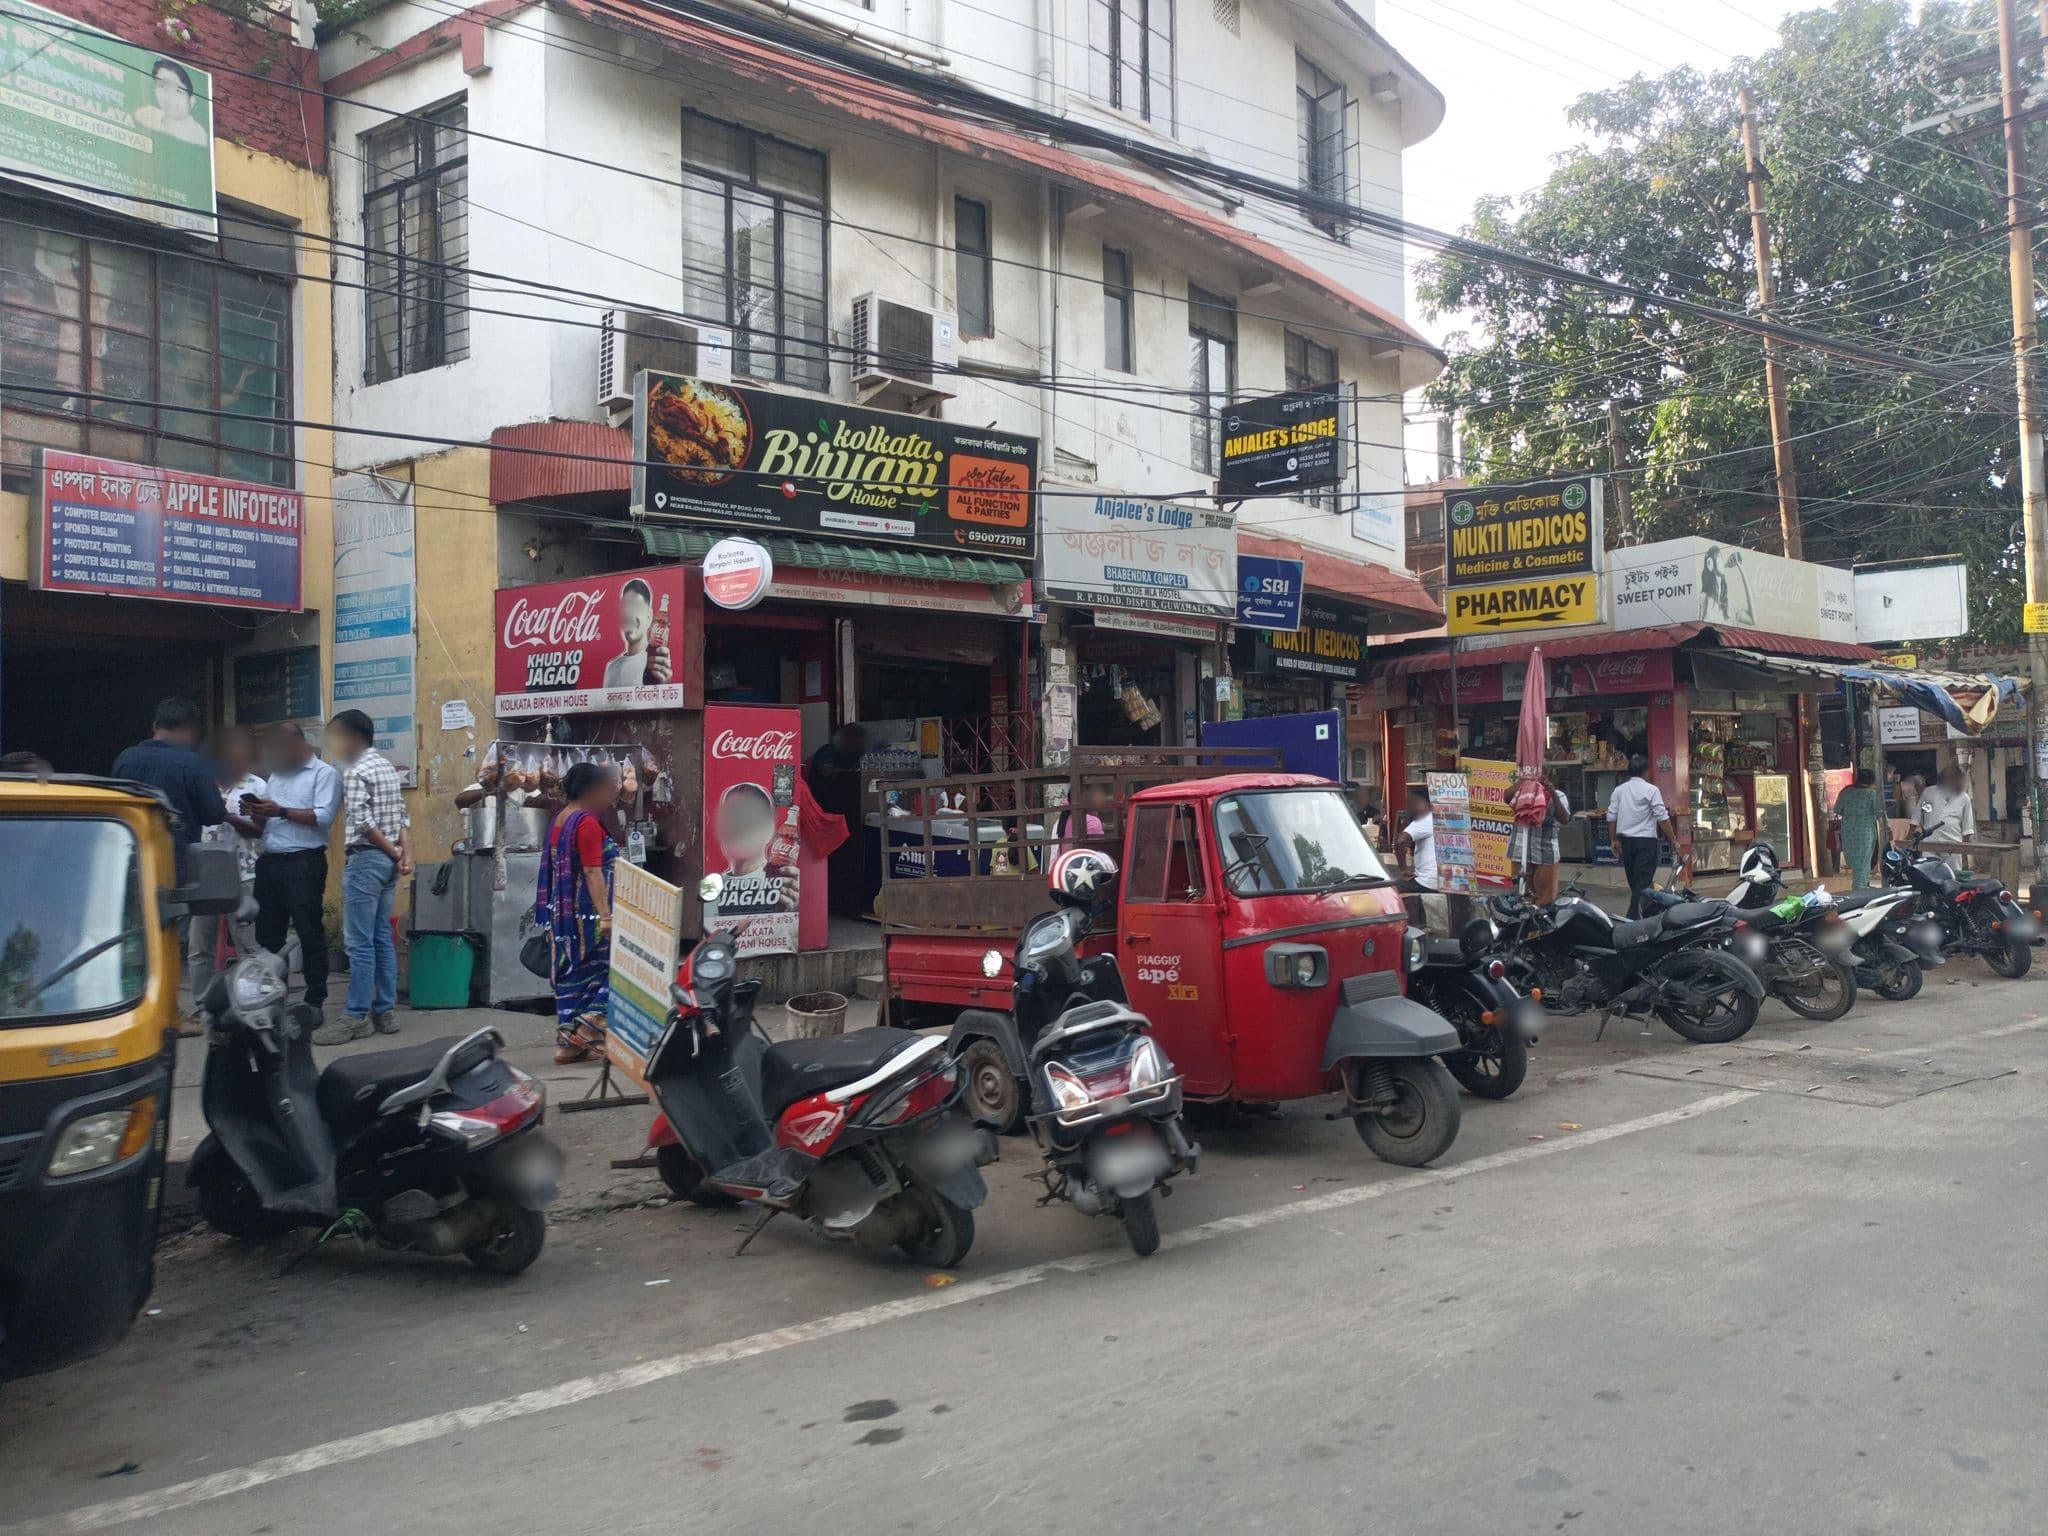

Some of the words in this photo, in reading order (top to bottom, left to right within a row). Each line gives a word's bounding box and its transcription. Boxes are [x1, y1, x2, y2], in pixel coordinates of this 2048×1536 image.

[833, 419, 933, 461] kolkata
[1224, 428, 1289, 459] ANJALEE'S
[1291, 416, 1337, 445] LODGE
[758, 430, 944, 503] Biryani
[849, 488, 898, 509] House
[957, 477, 1021, 502] ORDER
[165, 479, 219, 518] APPLE
[223, 488, 299, 529] INFOTECH
[956, 494, 973, 506] ALL
[974, 497, 1021, 512] FUNCTION
[64, 506, 100, 521] COMPUTER
[100, 510, 135, 525] EDUCATION
[965, 505, 974, 515] &
[974, 506, 1011, 520] PARTIES
[1094, 496, 1154, 523] Anjalee's
[1157, 504, 1193, 529] Lodge
[64, 521, 90, 535] SPOKEN
[91, 525, 119, 538] ENGLISH
[1453, 523, 1503, 558] MUKTI
[1507, 511, 1587, 551] MEDICOS
[968, 531, 1026, 547] 6900721781
[102, 543, 132, 555] PRINTING
[64, 552, 99, 567] COMPUTER
[99, 557, 120, 569] SALES
[126, 560, 156, 573] SERVICES
[1455, 560, 1510, 576] Medicine
[1512, 556, 1523, 569] &
[1525, 550, 1584, 568] Cosmetic
[63, 568, 90, 581] SCHOOL
[97, 572, 126, 585] COLLEGE
[125, 574, 157, 588] PROJECTS
[1106, 566, 1151, 584] BHABENDRA
[1153, 574, 1187, 588] COMPLEX
[1261, 577, 1290, 595] SBI
[1076, 592, 1086, 602] R.
[1096, 594, 1124, 606] ROAD,
[1125, 598, 1160, 609] DISPUR,
[1112, 583, 1143, 596] BACKSIDE
[1158, 589, 1182, 600] HOSTEL
[1456, 582, 1586, 618] PHARMACY
[1616, 590, 1655, 605] SWEET
[1658, 583, 1693, 600] POINT
[1277, 599, 1294, 608] ATM
[504, 590, 607, 649] Coca-Cola
[1820, 608, 1837, 620] SWEET
[1272, 625, 1311, 653] MUKTI
[1313, 628, 1361, 661] MEDICOS
[527, 652, 562, 668] KHUD
[566, 650, 583, 664] KO
[525, 665, 581, 686] JAGAO
[500, 697, 532, 712] KOLKATA
[533, 695, 563, 709] BIRYANI
[564, 694, 589, 707] HOUSE
[711, 729, 798, 760] Coca-Cola
[1427, 773, 1468, 789] XEROX
[1438, 789, 1467, 797] Print
[1490, 808, 1514, 817] Cosmet
[1477, 842, 1493, 850] AND
[1487, 835, 1509, 843] SUGA
[1477, 853, 1504, 862] CHECK
[764, 877, 783, 889] KO
[718, 889, 781, 907] JAGAO
[740, 927, 774, 938] OLKATA
[735, 939, 756, 950] YANI
[758, 937, 788, 948] HOUSE
[1137, 955, 1180, 965] PIAGGIO
[1138, 966, 1179, 984] apé
